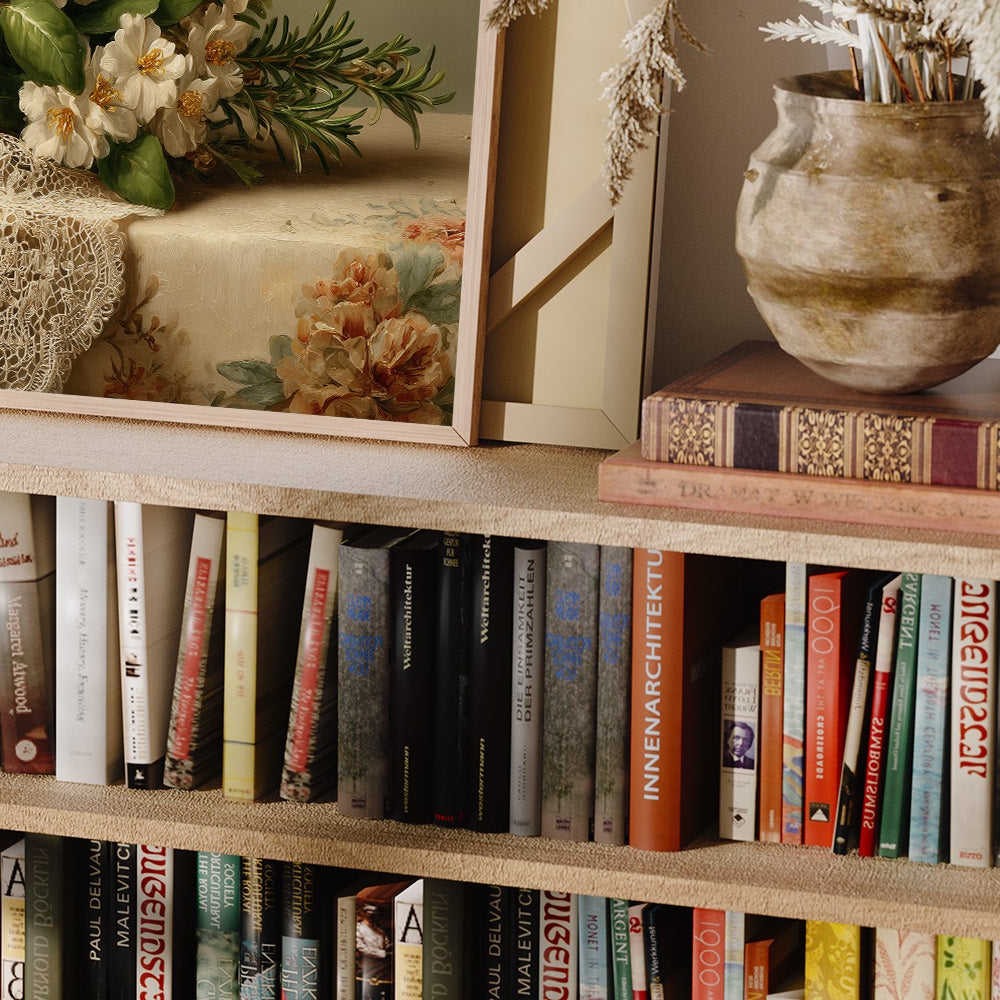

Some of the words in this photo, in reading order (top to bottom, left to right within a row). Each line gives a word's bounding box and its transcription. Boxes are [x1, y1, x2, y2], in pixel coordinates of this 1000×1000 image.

[5, 595, 24, 657] Margaret
[402, 562, 413, 670] Weltarchitektur
[525, 558, 535, 679] PRIMZAHLEN
[11, 660, 32, 714] Atwood
[524, 684, 532, 722] DER
[402, 744, 410, 813] westermann
[89, 916, 102, 961] PAUL
[586, 913, 598, 951] MONET
[648, 925, 660, 974] Werkkunst
[693, 920, 721, 986] 1900
